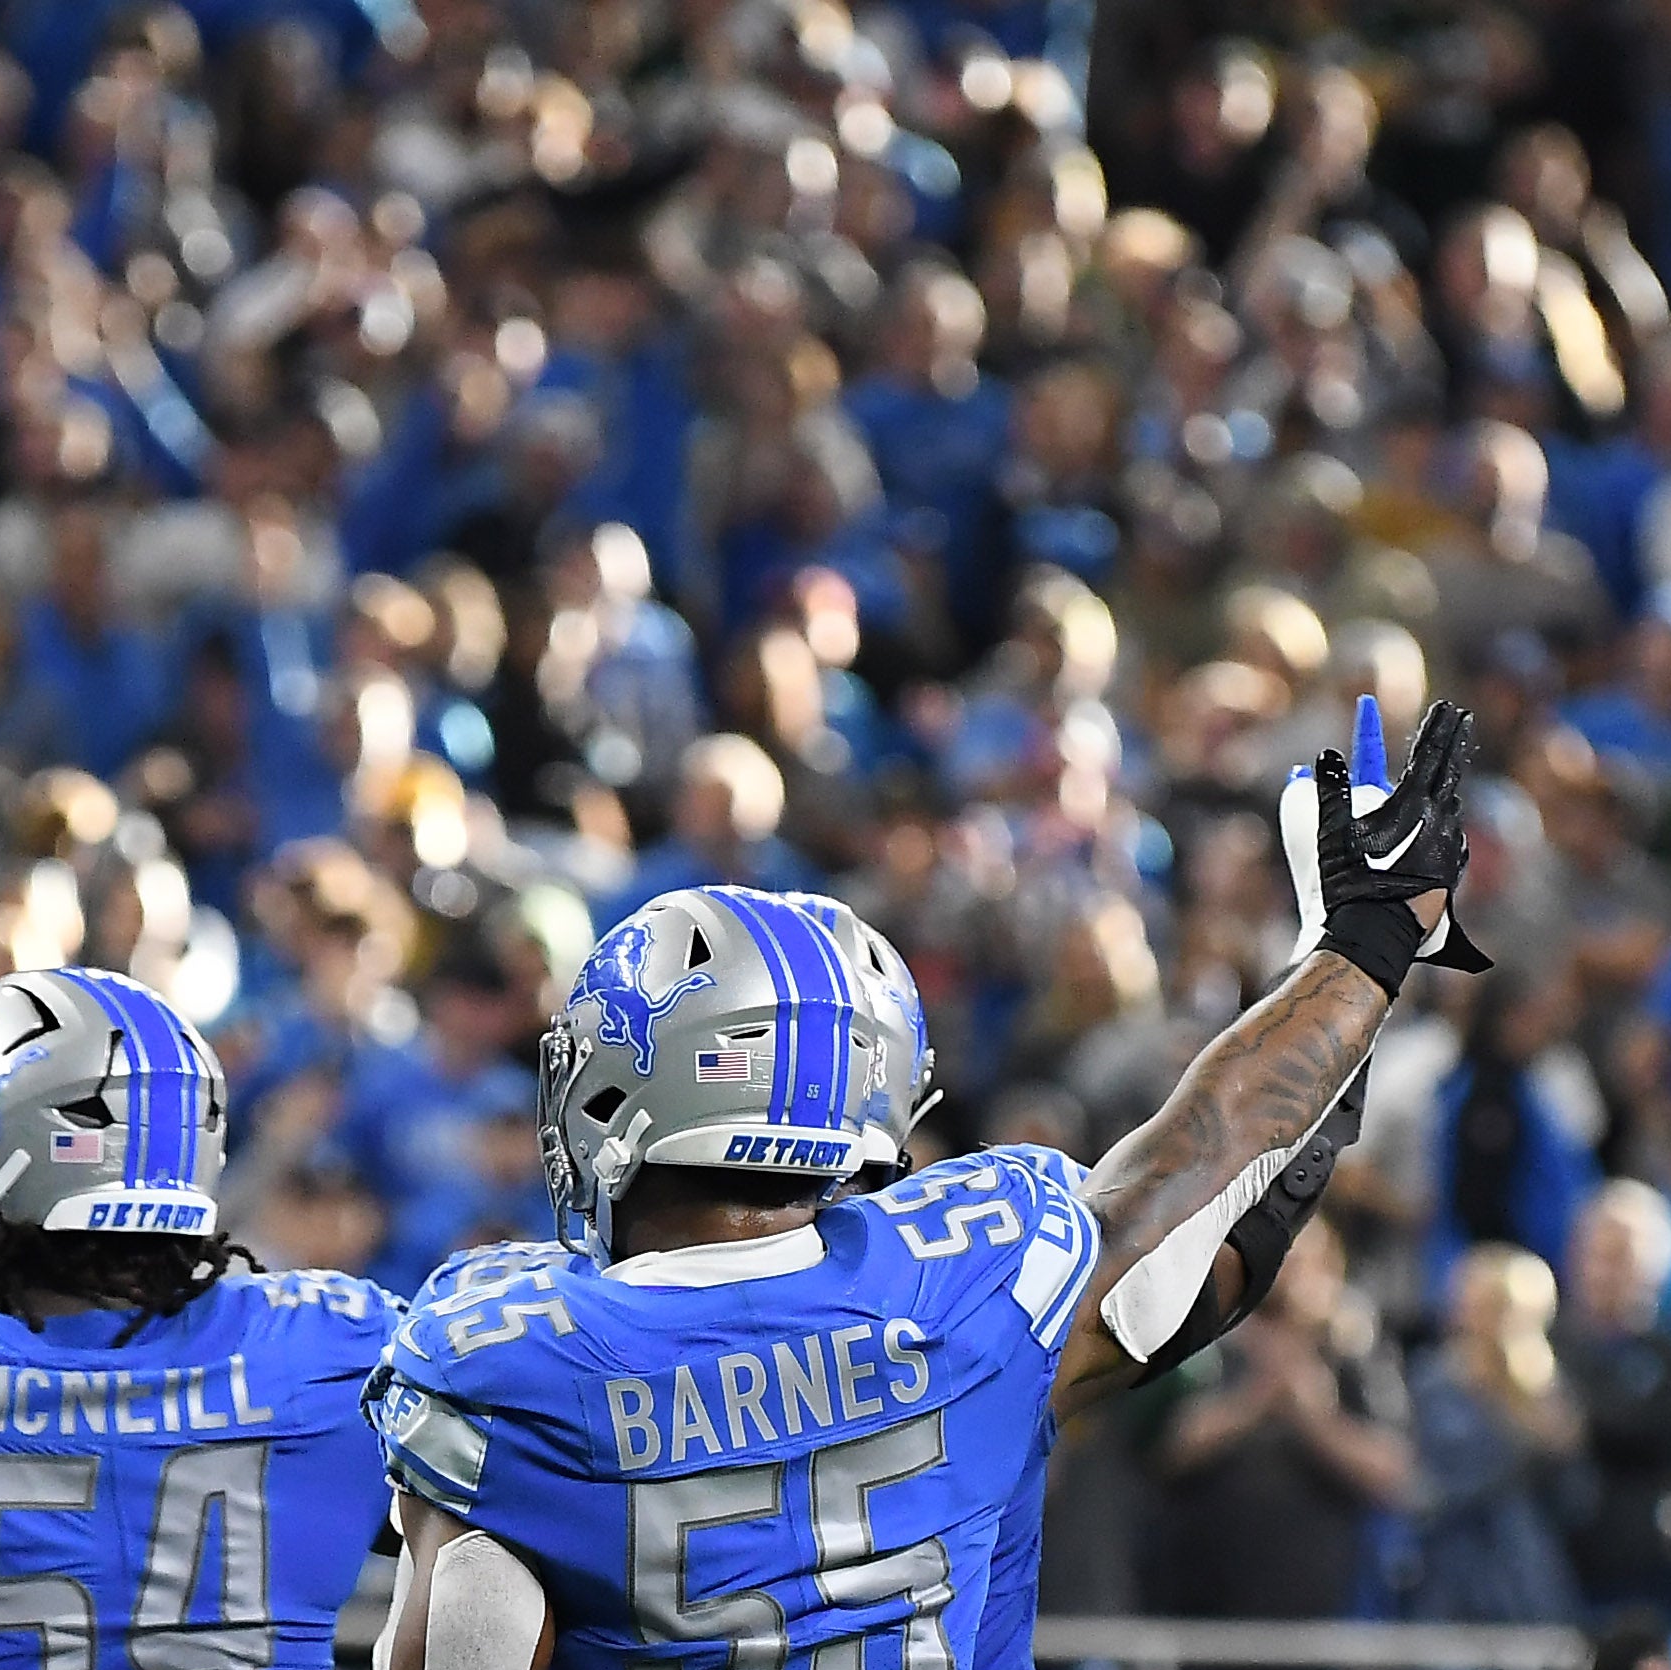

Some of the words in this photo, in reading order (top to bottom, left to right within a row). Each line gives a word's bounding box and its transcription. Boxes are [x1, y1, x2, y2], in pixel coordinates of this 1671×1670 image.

[724, 1134, 852, 1168] DETROIT
[88, 1203, 207, 1230] DETROIT
[604, 1316, 930, 1472] BARNES
